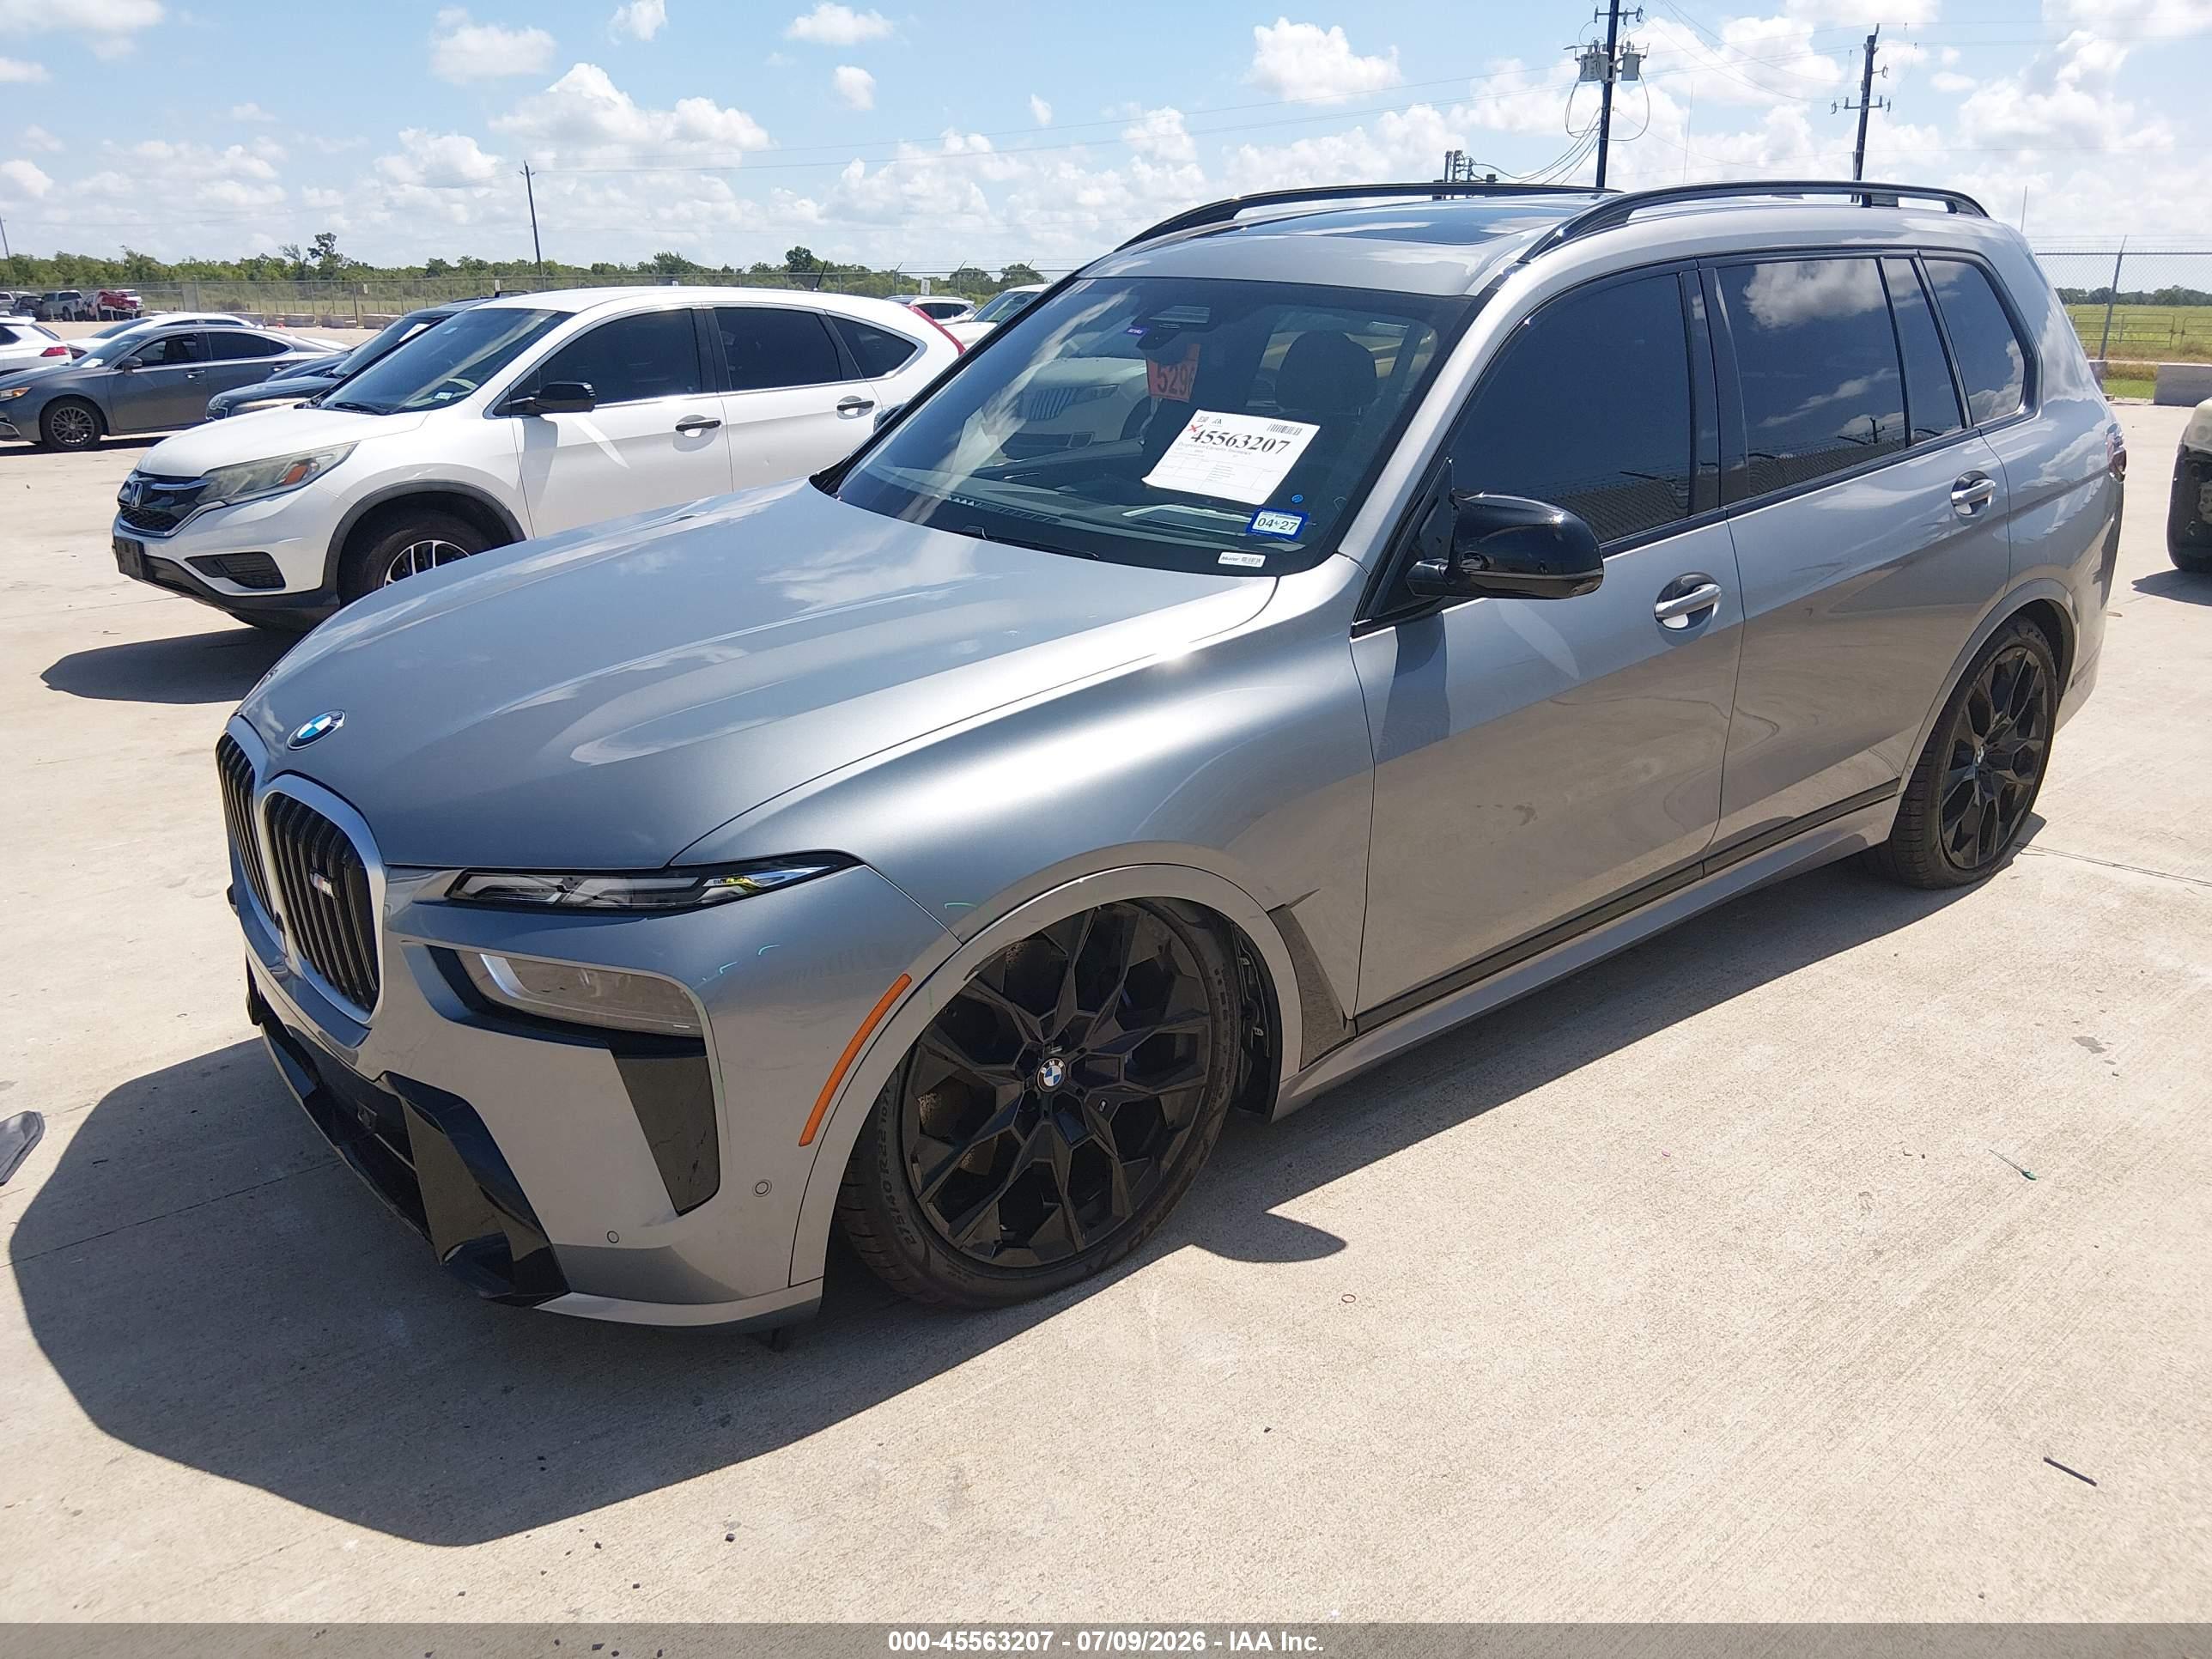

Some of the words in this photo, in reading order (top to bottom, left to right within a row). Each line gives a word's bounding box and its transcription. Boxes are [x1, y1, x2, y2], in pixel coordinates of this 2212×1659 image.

[1190, 428, 1291, 454] 45563207
[1257, 517, 1274, 529] 04
[1279, 520, 1298, 532] 27
[878, 1128, 890, 1175] R22
